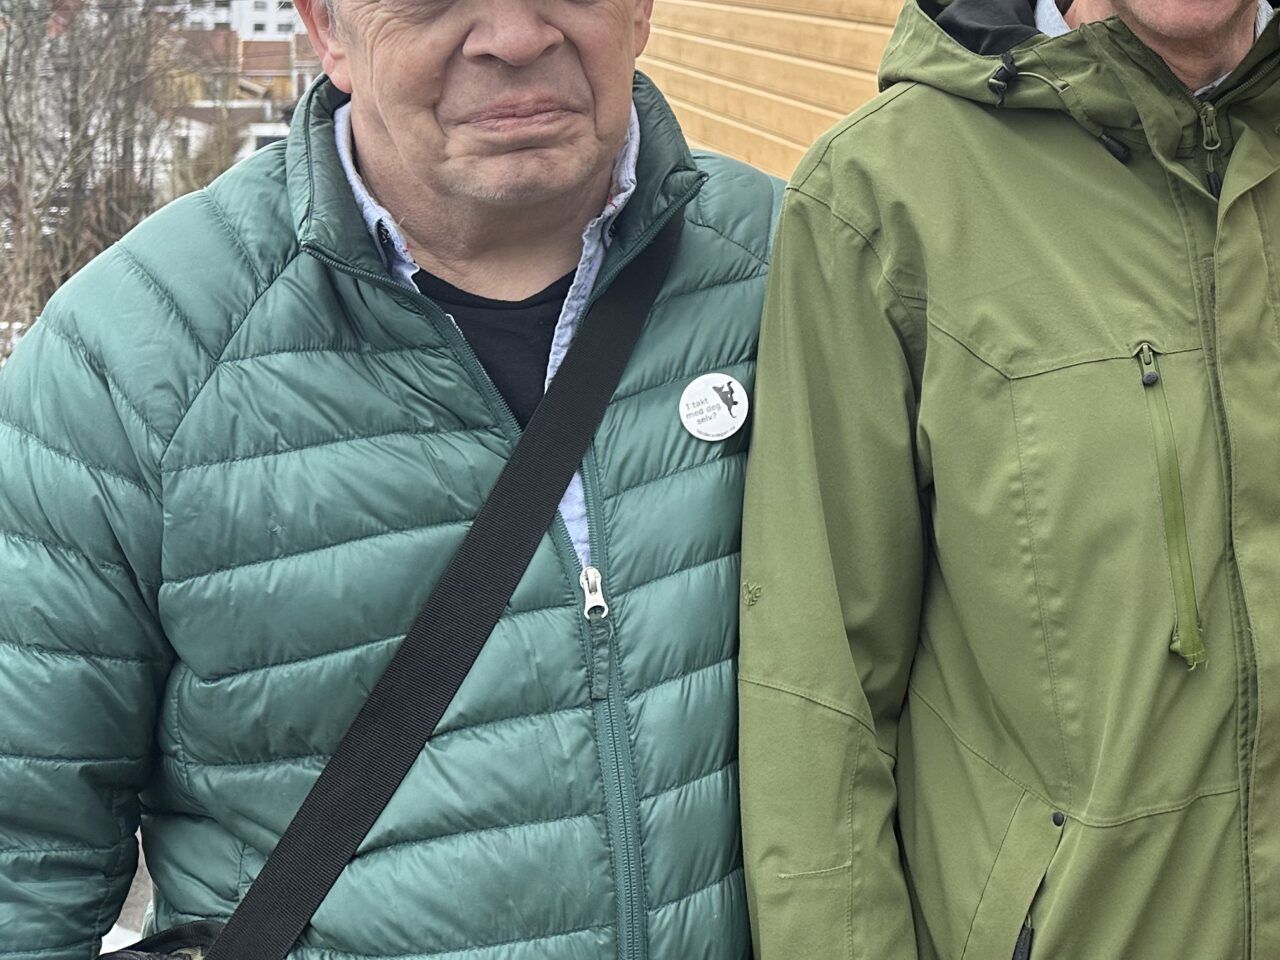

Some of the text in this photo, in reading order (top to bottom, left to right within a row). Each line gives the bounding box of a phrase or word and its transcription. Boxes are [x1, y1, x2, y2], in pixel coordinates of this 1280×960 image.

[692, 398, 710, 409] takt
[686, 403, 721, 420] med deg
